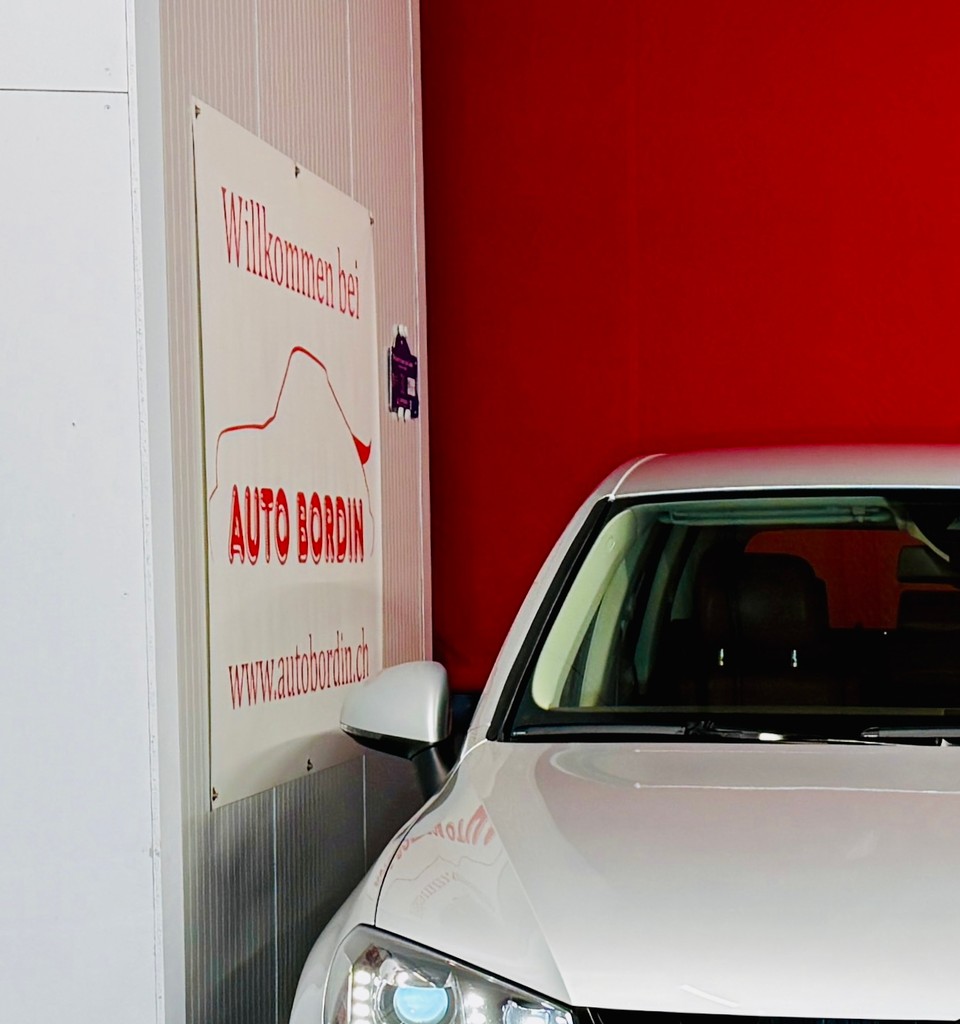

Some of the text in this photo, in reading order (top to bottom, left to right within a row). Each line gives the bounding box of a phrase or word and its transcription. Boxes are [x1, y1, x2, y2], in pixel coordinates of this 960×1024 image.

[221, 186, 360, 320] Willkommen bei
[228, 484, 364, 566] AUTO BORDIN
[228, 627, 369, 710] www.autobordin.ch
